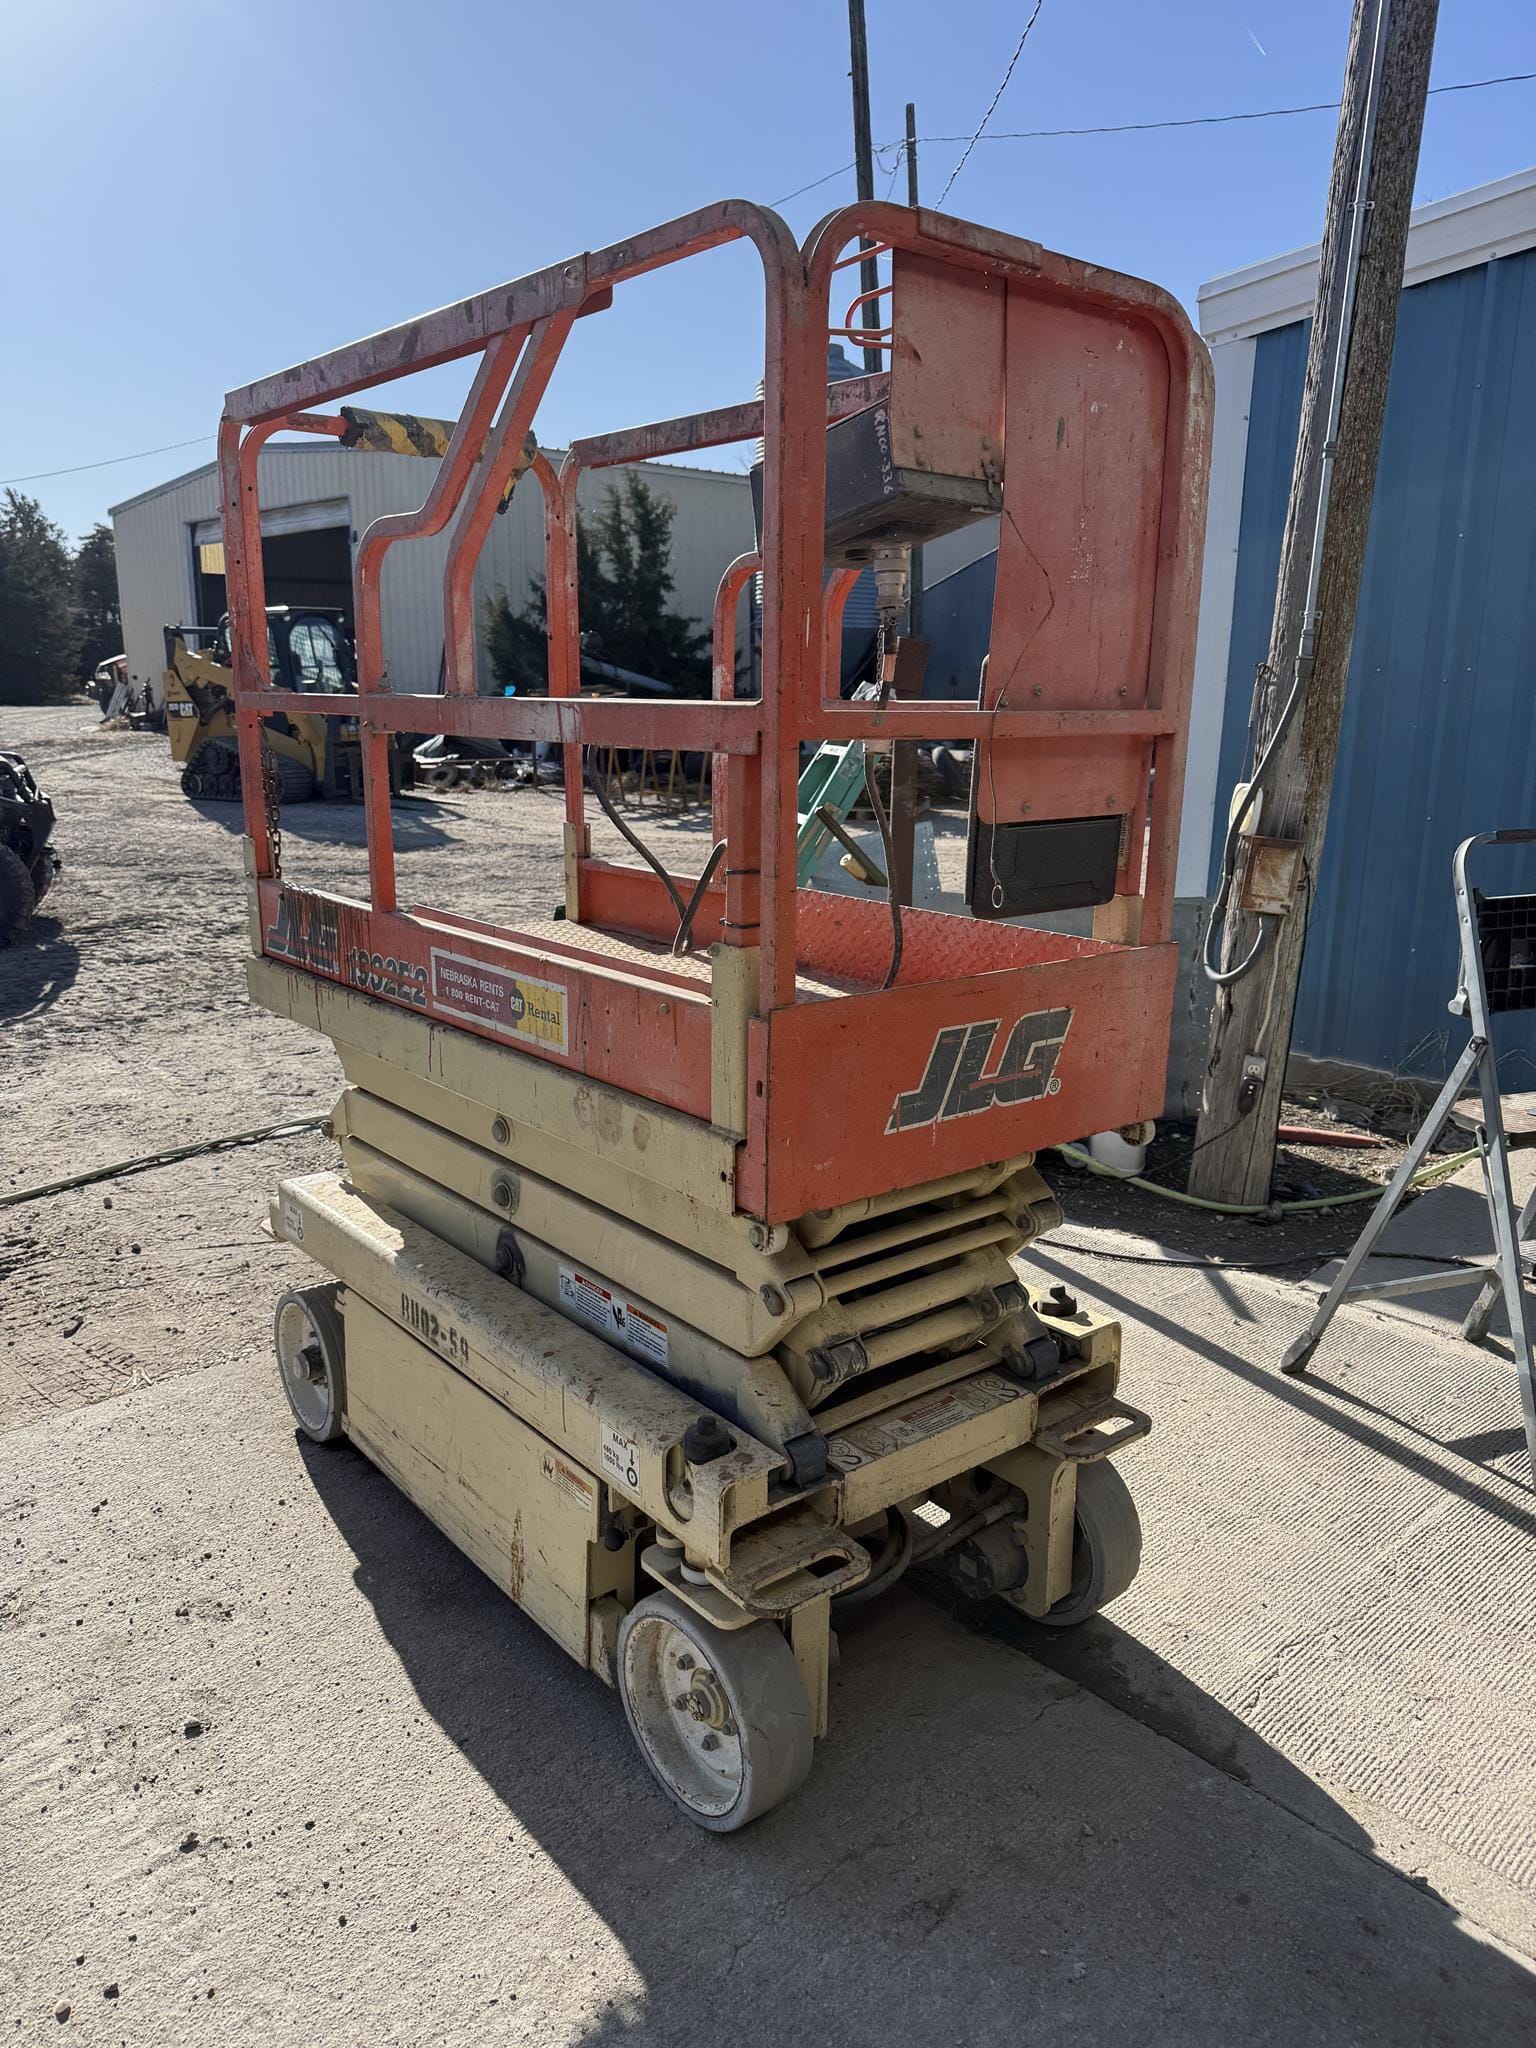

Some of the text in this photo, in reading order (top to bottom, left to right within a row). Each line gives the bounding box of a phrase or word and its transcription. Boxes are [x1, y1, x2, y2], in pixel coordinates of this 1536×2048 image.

[440, 966, 504, 998] NEBRASKA RENTS
[465, 992, 500, 1013] RENT-CAT
[510, 996, 561, 1026] CAT Rental
[884, 1006, 1076, 1136] JLG
[612, 1432, 628, 1451] MAX
